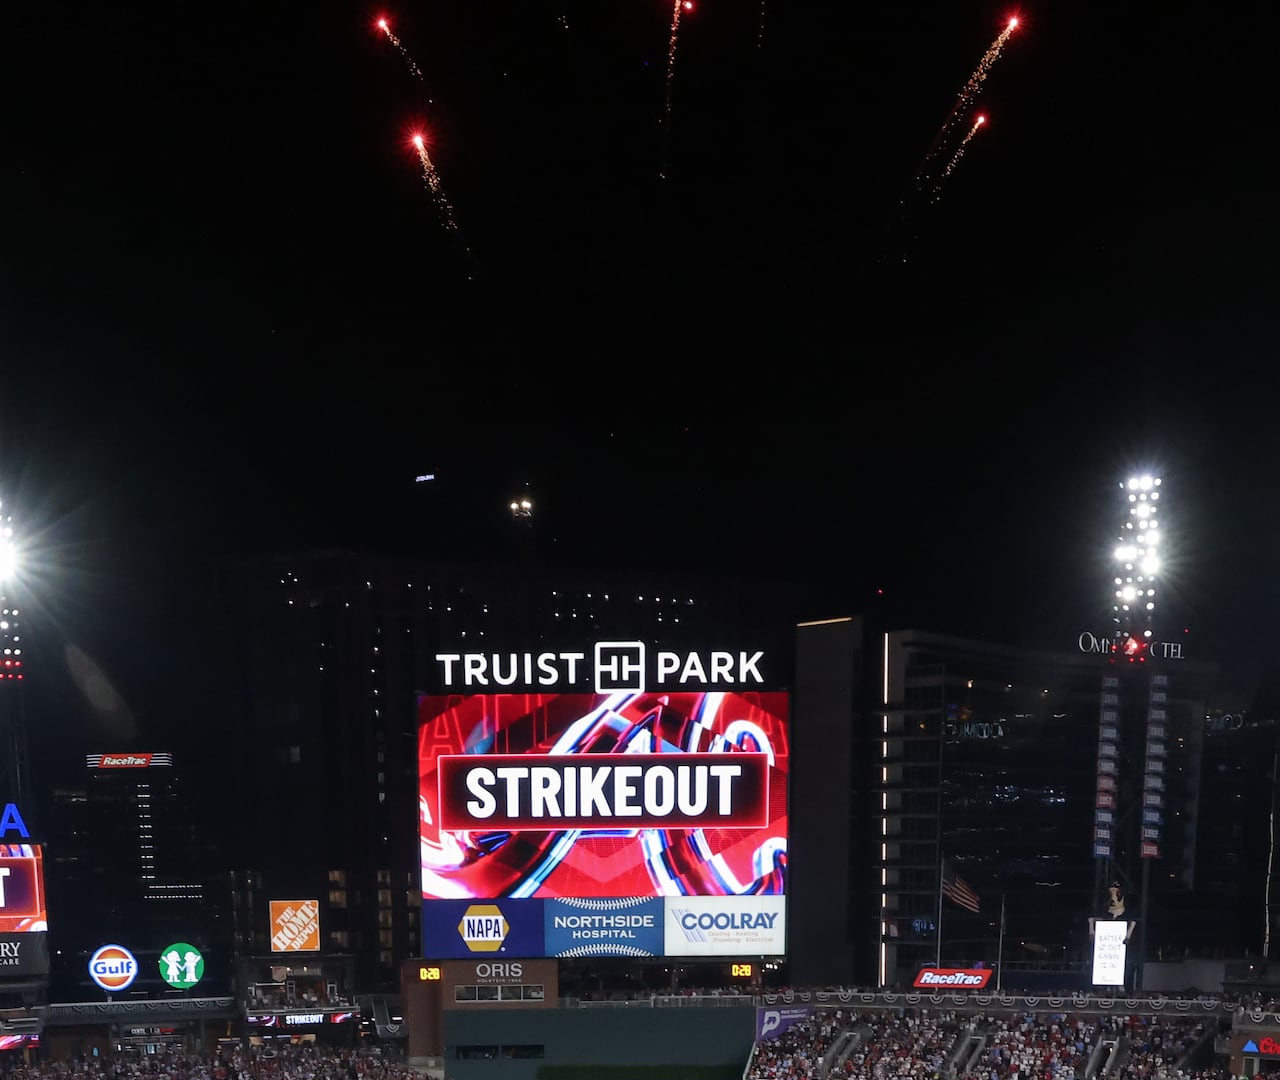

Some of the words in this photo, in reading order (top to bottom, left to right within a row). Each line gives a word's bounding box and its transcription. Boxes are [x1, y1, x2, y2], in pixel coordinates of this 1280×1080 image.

[435, 652, 584, 685] TRUIST
[656, 651, 765, 683] PARK
[103, 756, 147, 766] RaceTrac
[465, 765, 742, 819] STRIKEOUT
[276, 906, 297, 927] THE
[554, 915, 654, 928] NORTHSIDE
[681, 912, 779, 930] COOLRAY
[271, 900, 319, 950] HOME
[467, 918, 502, 938] NAPA
[290, 919, 319, 950] DEPOT
[572, 930, 636, 939] HOSPITAL
[93, 960, 133, 975] Gulf
[475, 963, 523, 977] ORIS
[731, 964, 752, 976] 0:28
[920, 972, 984, 985] RaceTrac
[285, 1014, 324, 1025] STRIKEOUT
